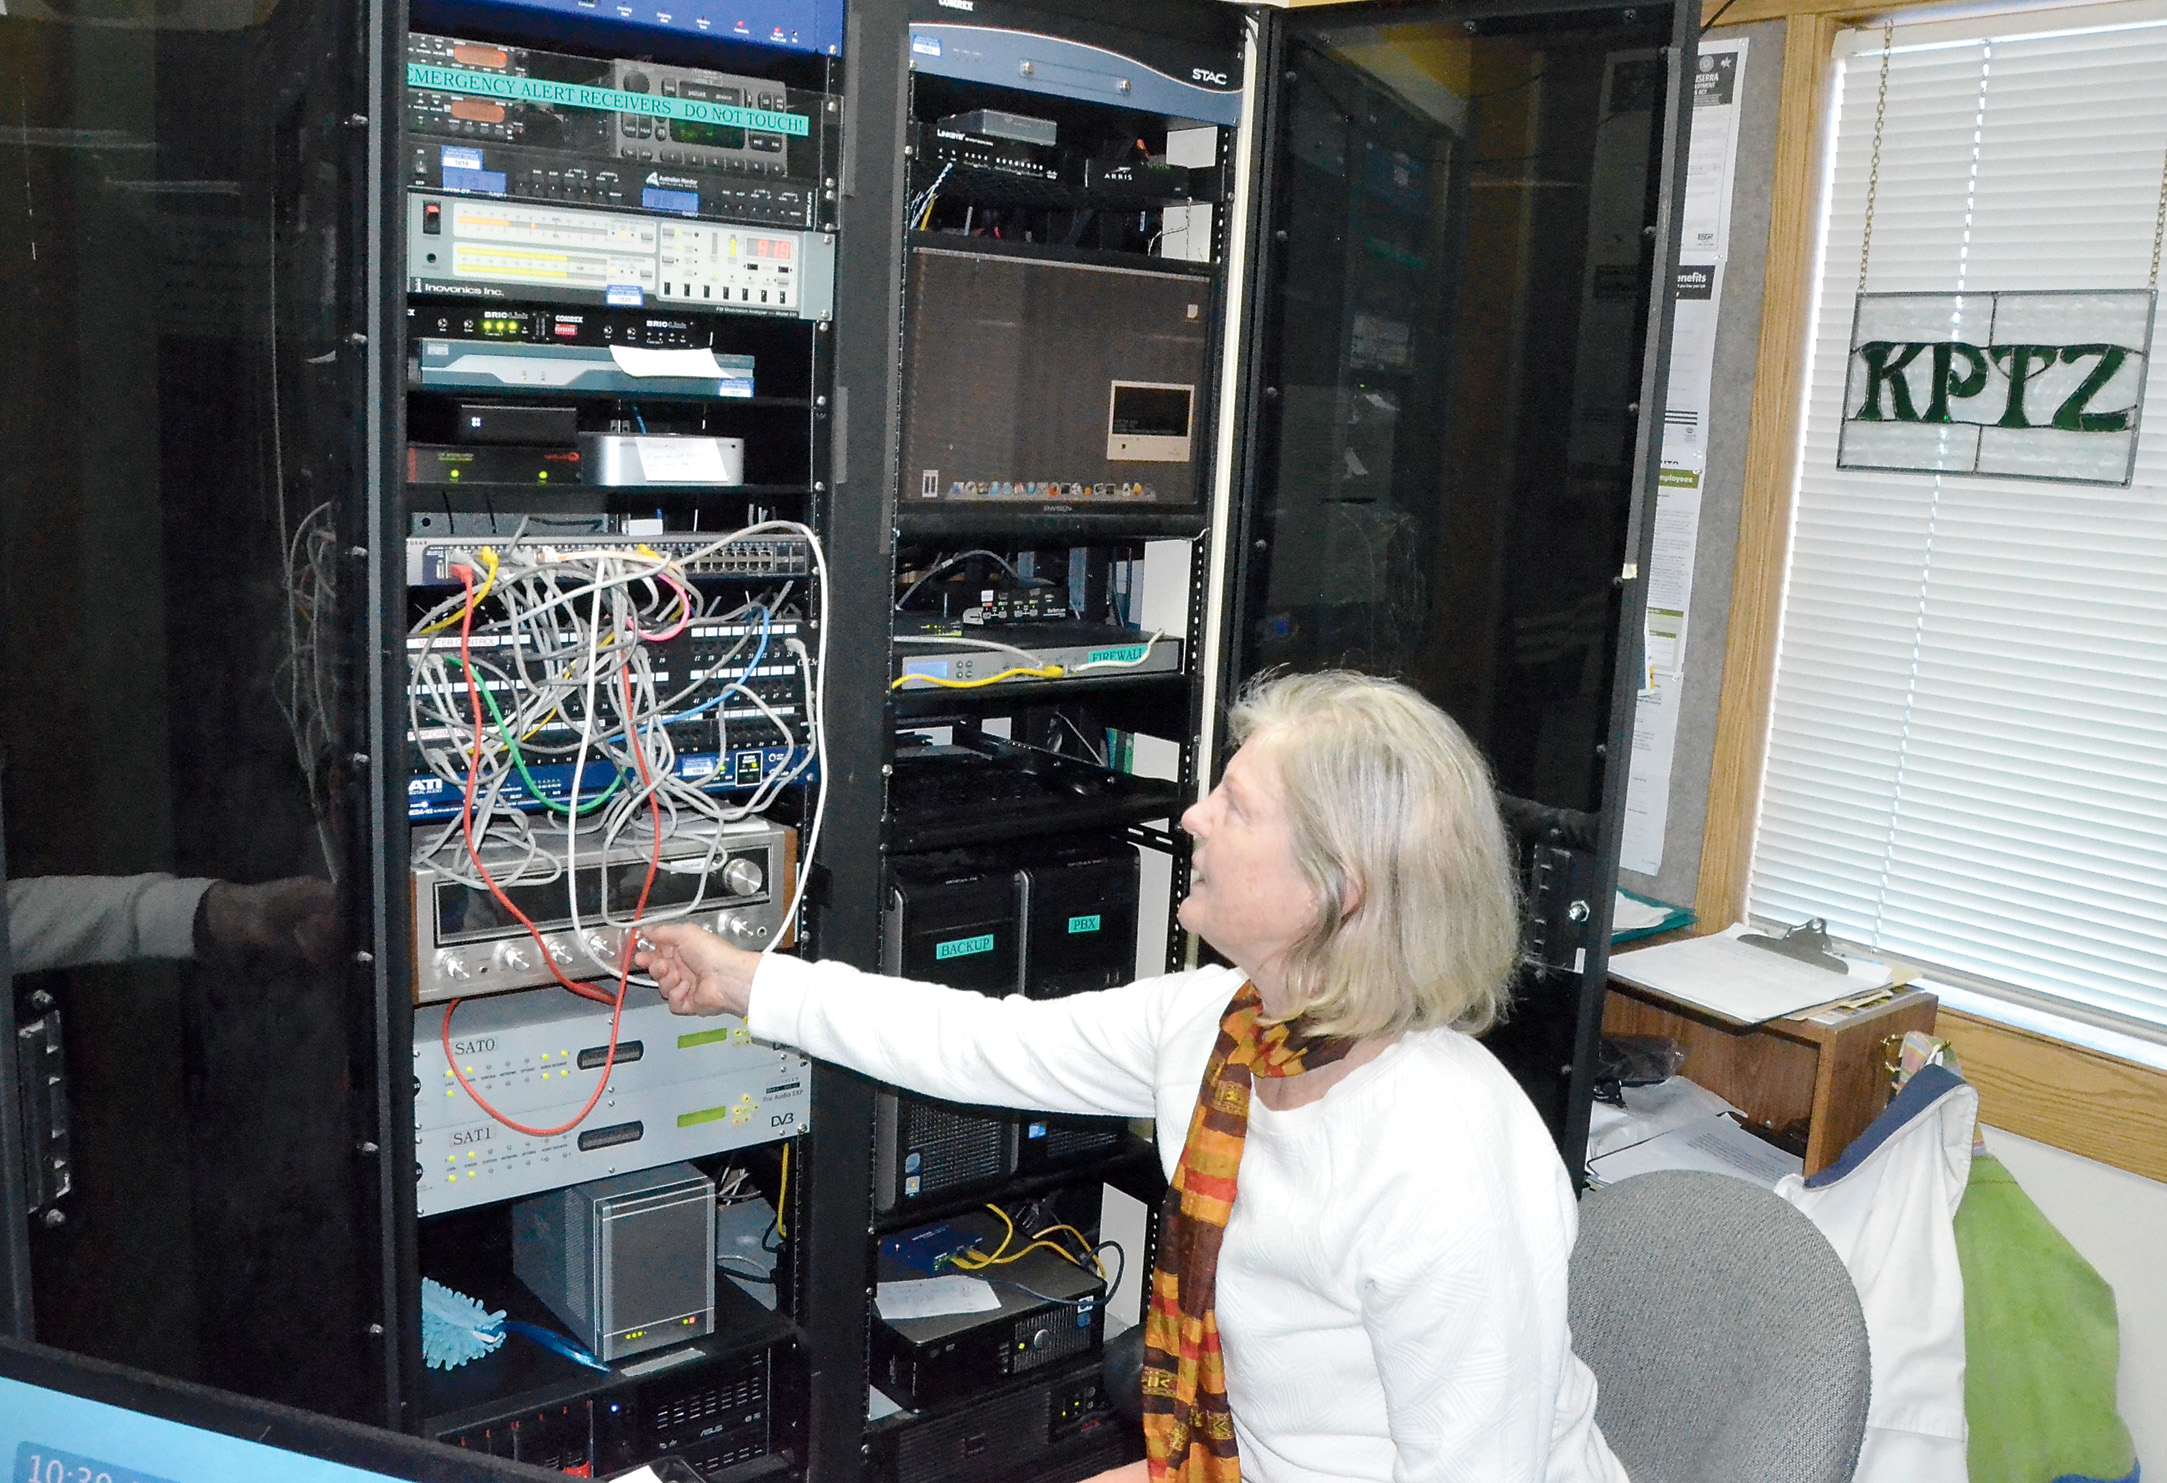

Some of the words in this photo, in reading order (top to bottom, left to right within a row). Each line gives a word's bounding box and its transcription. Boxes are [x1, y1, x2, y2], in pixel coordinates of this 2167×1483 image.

[1192, 68, 1227, 85] STAC
[408, 68, 516, 94] EMERGENCY
[521, 83, 575, 102] ALERT
[580, 89, 672, 114] RECEIVERS
[684, 104, 707, 118] DO
[712, 107, 742, 123] NOT
[747, 113, 803, 131] TOUCH!
[1104, 173, 1133, 181] ARRIS
[424, 283, 482, 295] Inovonics
[484, 287, 505, 297] Inc.
[1857, 341, 2131, 432] KPTZ
[408, 779, 443, 791] ATI
[1073, 918, 1097, 931] PBX
[941, 938, 990, 956] BACKUP
[774, 1093, 791, 1101] Audio
[771, 1112, 794, 1127] DVB
